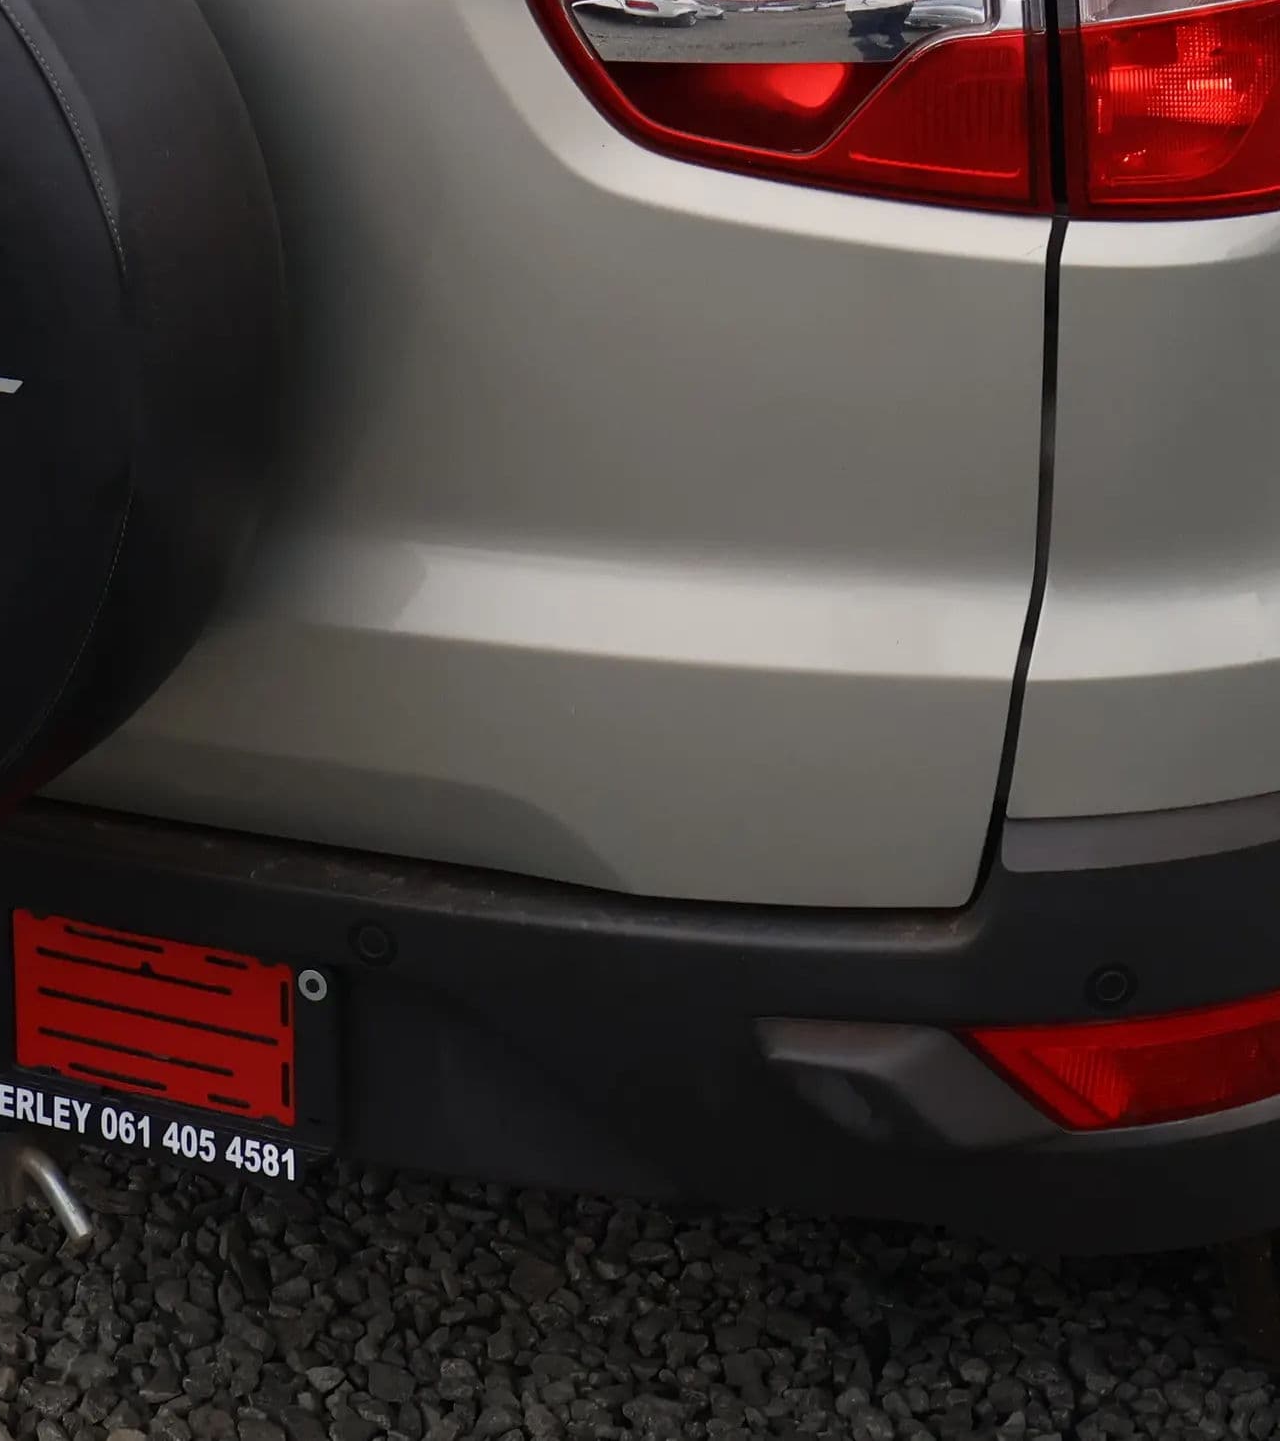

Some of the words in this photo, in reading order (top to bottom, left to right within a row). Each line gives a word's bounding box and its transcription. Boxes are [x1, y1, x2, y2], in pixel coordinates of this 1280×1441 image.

[100, 1107, 150, 1148] 061
[162, 1121, 217, 1163] 405
[225, 1136, 296, 1181] 4581
